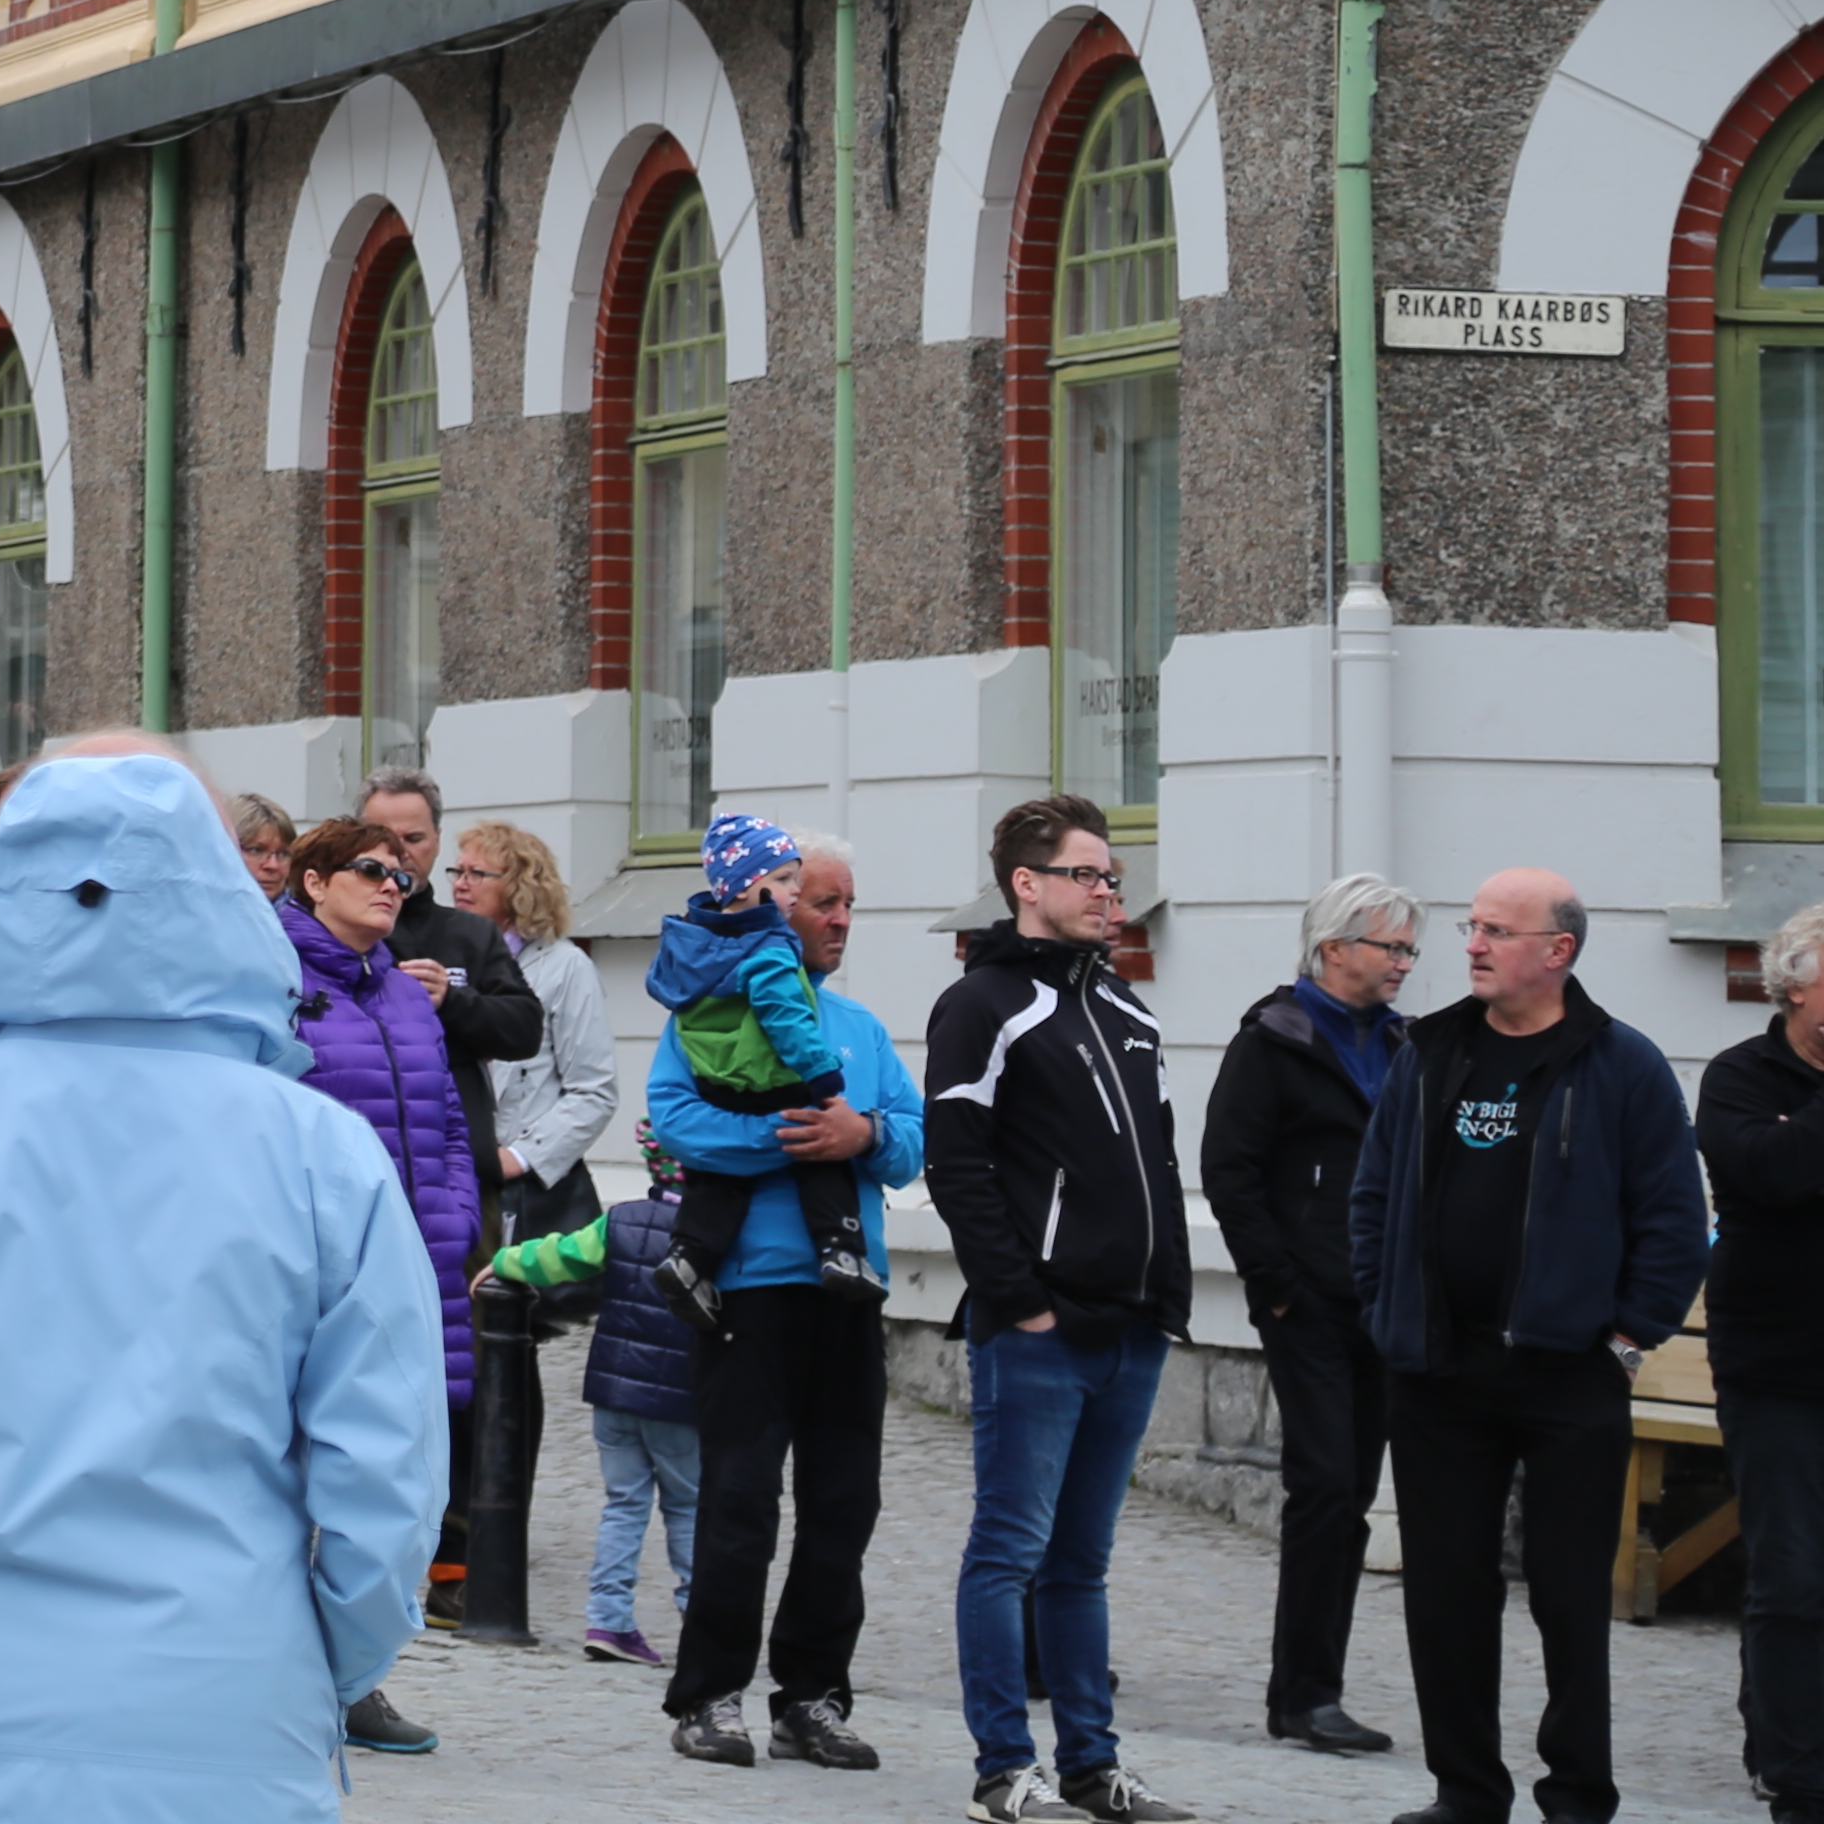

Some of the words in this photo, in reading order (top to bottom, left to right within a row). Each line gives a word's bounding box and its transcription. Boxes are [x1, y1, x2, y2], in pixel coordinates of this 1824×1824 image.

[1397, 293, 1483, 319] RIKARD
[1498, 298, 1612, 324] KAARBØS
[1463, 323, 1543, 348] PLASS
